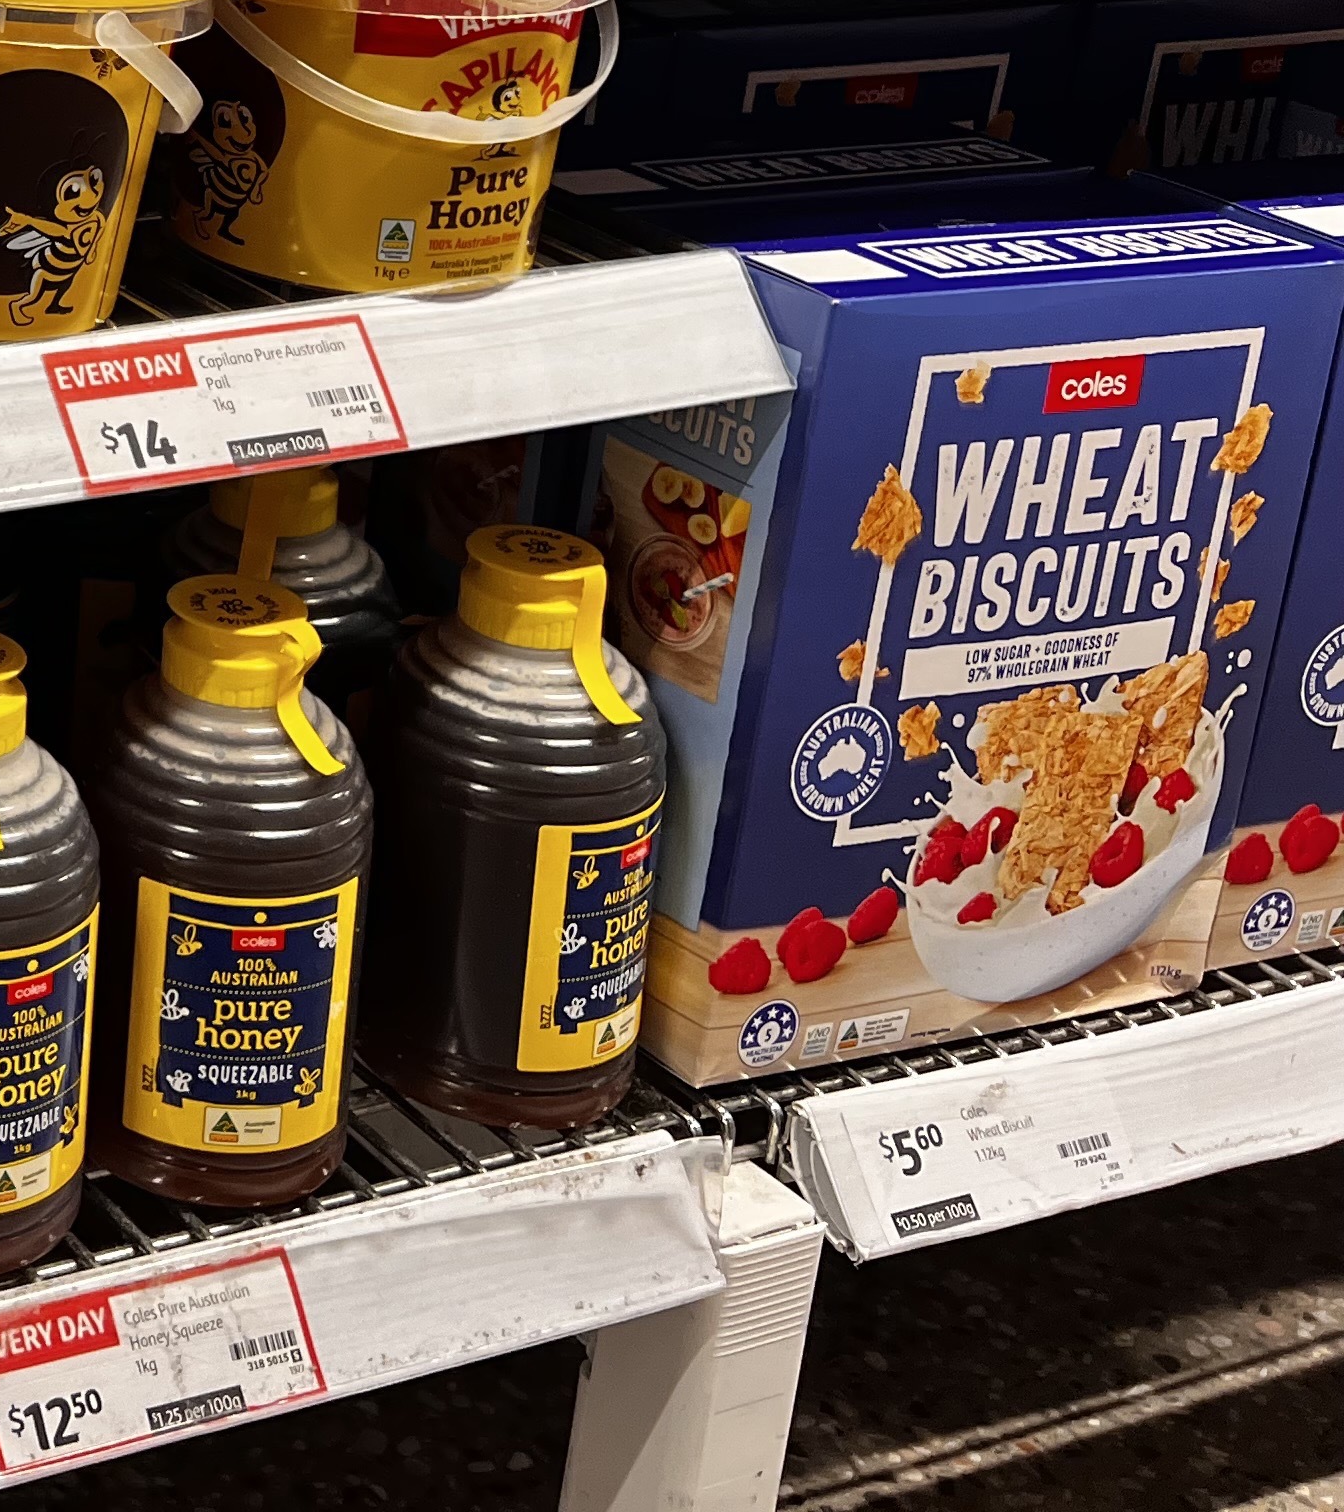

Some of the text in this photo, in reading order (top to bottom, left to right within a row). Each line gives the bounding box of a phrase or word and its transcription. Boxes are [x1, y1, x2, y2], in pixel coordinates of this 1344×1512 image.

[448, 163, 531, 197] Pure
[426, 193, 531, 233] Honey
[54, 352, 183, 391] EVERY DAY
[1060, 370, 1127, 401] coles
[101, 419, 178, 469] $14
[232, 434, 325, 460] $1.40 per 100g
[933, 418, 1219, 548] WHEAT
[908, 532, 1191, 640] BISCUITS
[967, 650, 1111, 683] 97% WHOLEGRAIN WHEAT
[197, 1063, 295, 1085] SQUEEZABLE
[975, 1145, 1006, 1163] 1.12kg
[897, 1201, 975, 1230] $0.50 per 100g
[58, 1307, 106, 1342] DAY
